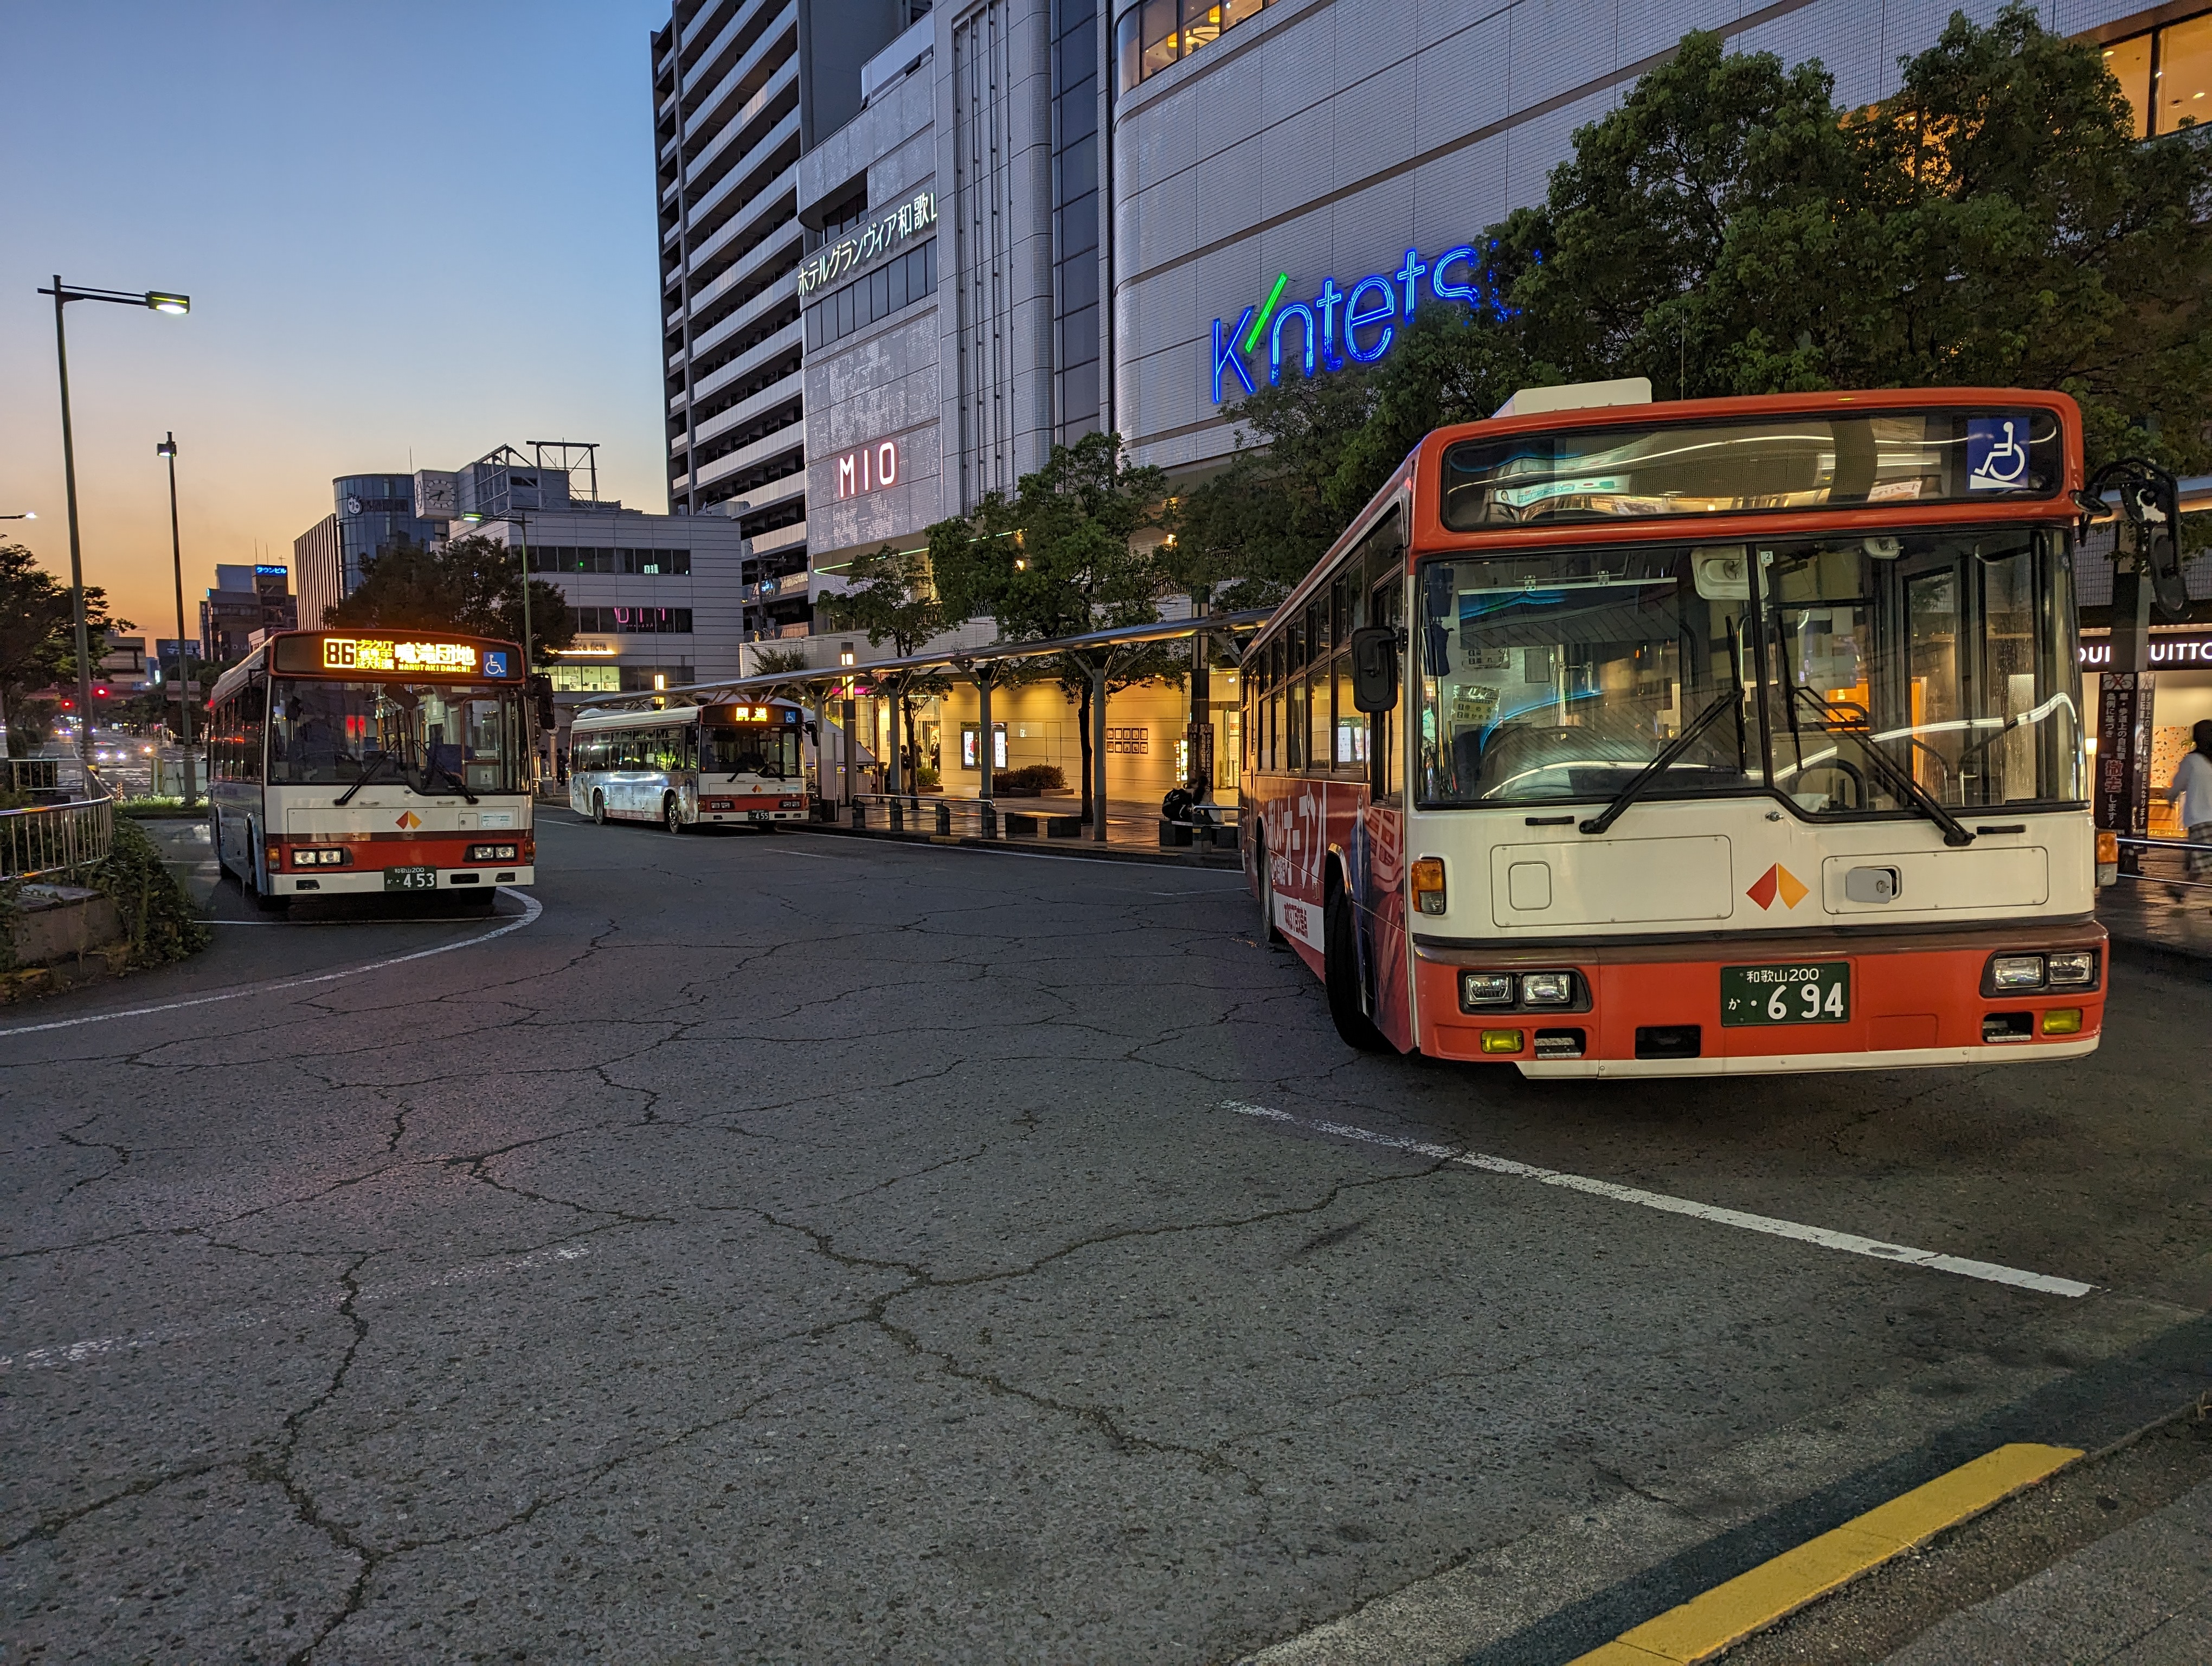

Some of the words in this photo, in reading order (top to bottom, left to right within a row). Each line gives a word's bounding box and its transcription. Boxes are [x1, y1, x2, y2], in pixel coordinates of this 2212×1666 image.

[1212, 240, 1518, 403] Kintets
[839, 441, 896, 498] MIO
[325, 640, 355, 666] 86
[395, 642, 476, 665] 鳴滝団地
[2147, 642, 2212, 661] UITTO
[440, 665, 471, 673] DANCHI
[403, 873, 435, 888] 453
[1746, 968, 1819, 983] 和歌山200
[1728, 998, 1740, 1010] か
